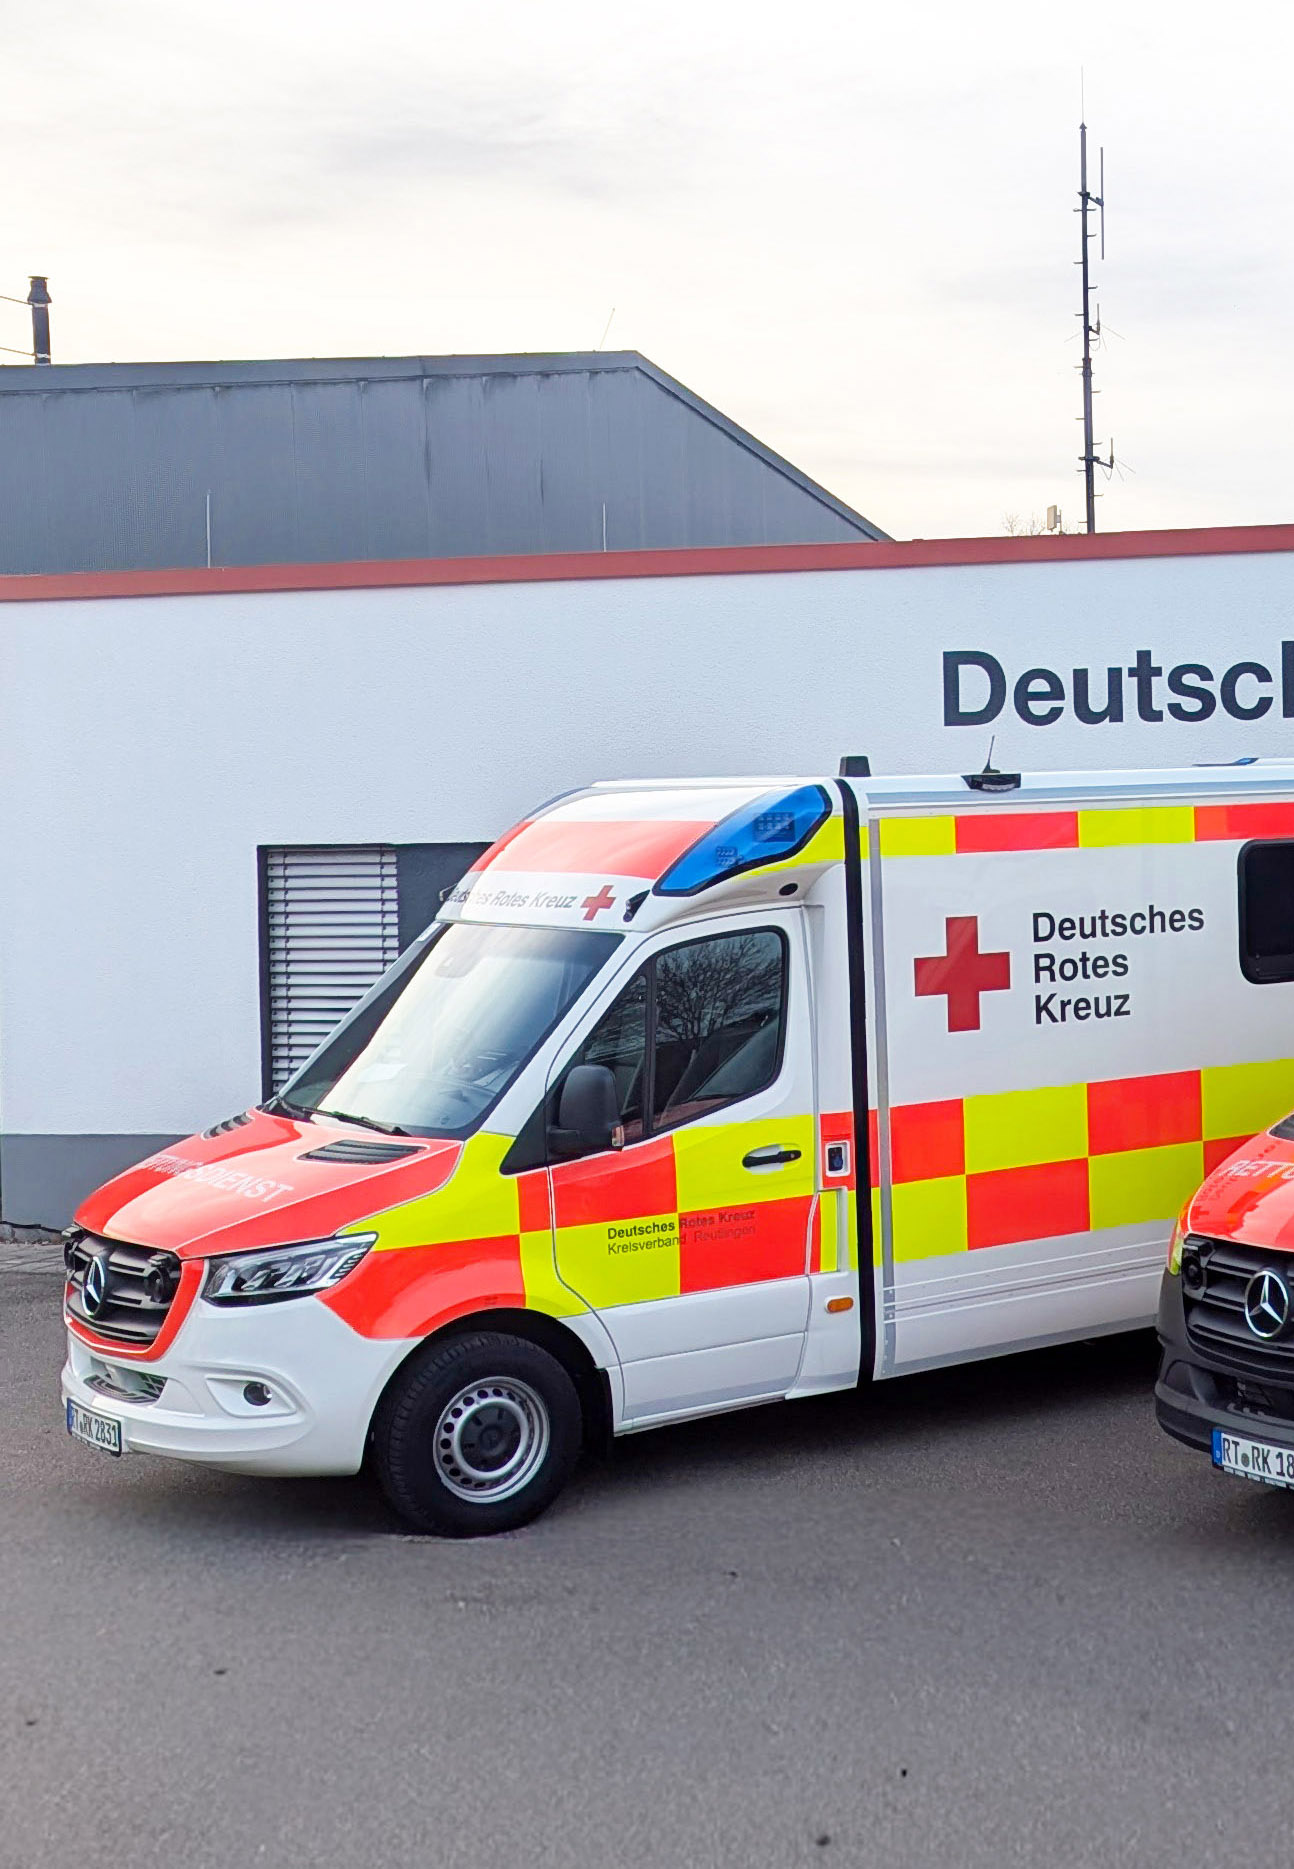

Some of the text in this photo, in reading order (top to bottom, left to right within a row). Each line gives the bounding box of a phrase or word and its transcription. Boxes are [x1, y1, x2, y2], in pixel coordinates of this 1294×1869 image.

[528, 891, 577, 909] Kreuz
[1033, 904, 1204, 942] Deutsches
[1034, 951, 1129, 984] Rotes
[1035, 993, 1131, 1025] Kreuz
[607, 1220, 675, 1240] Deutsches
[607, 1234, 686, 1256] Kreisverband
[95, 1418, 118, 1448] 2831
[1222, 1437, 1240, 1465] RT
[1251, 1445, 1272, 1475] RK
